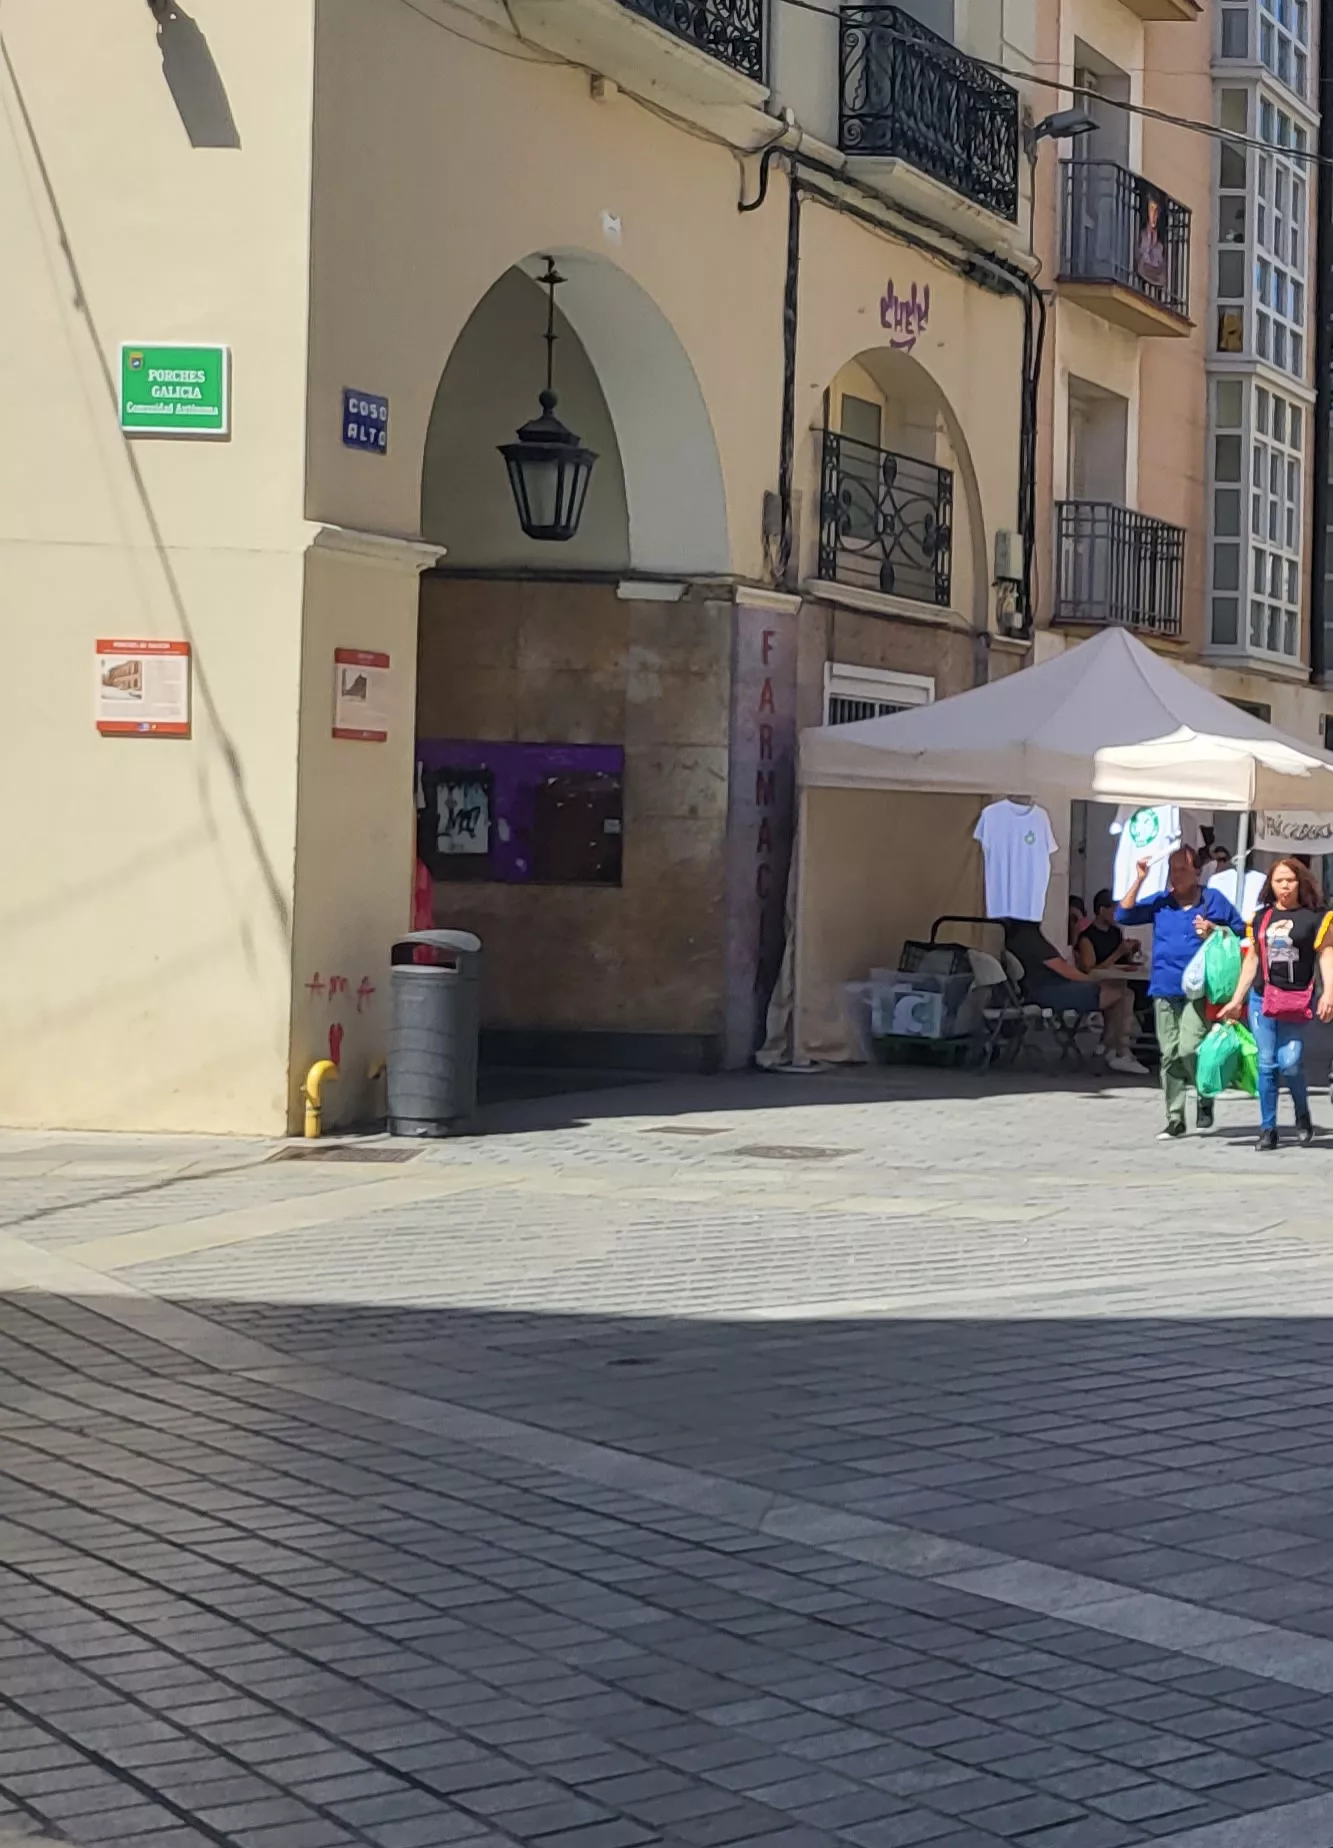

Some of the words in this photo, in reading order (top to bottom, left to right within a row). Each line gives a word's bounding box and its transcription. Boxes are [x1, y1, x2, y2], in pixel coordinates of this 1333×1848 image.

[147, 369, 206, 383] PORCHES
[151, 385, 202, 399] GALICIA
[349, 398, 387, 421] COSO
[347, 423, 386, 446] ALTO
